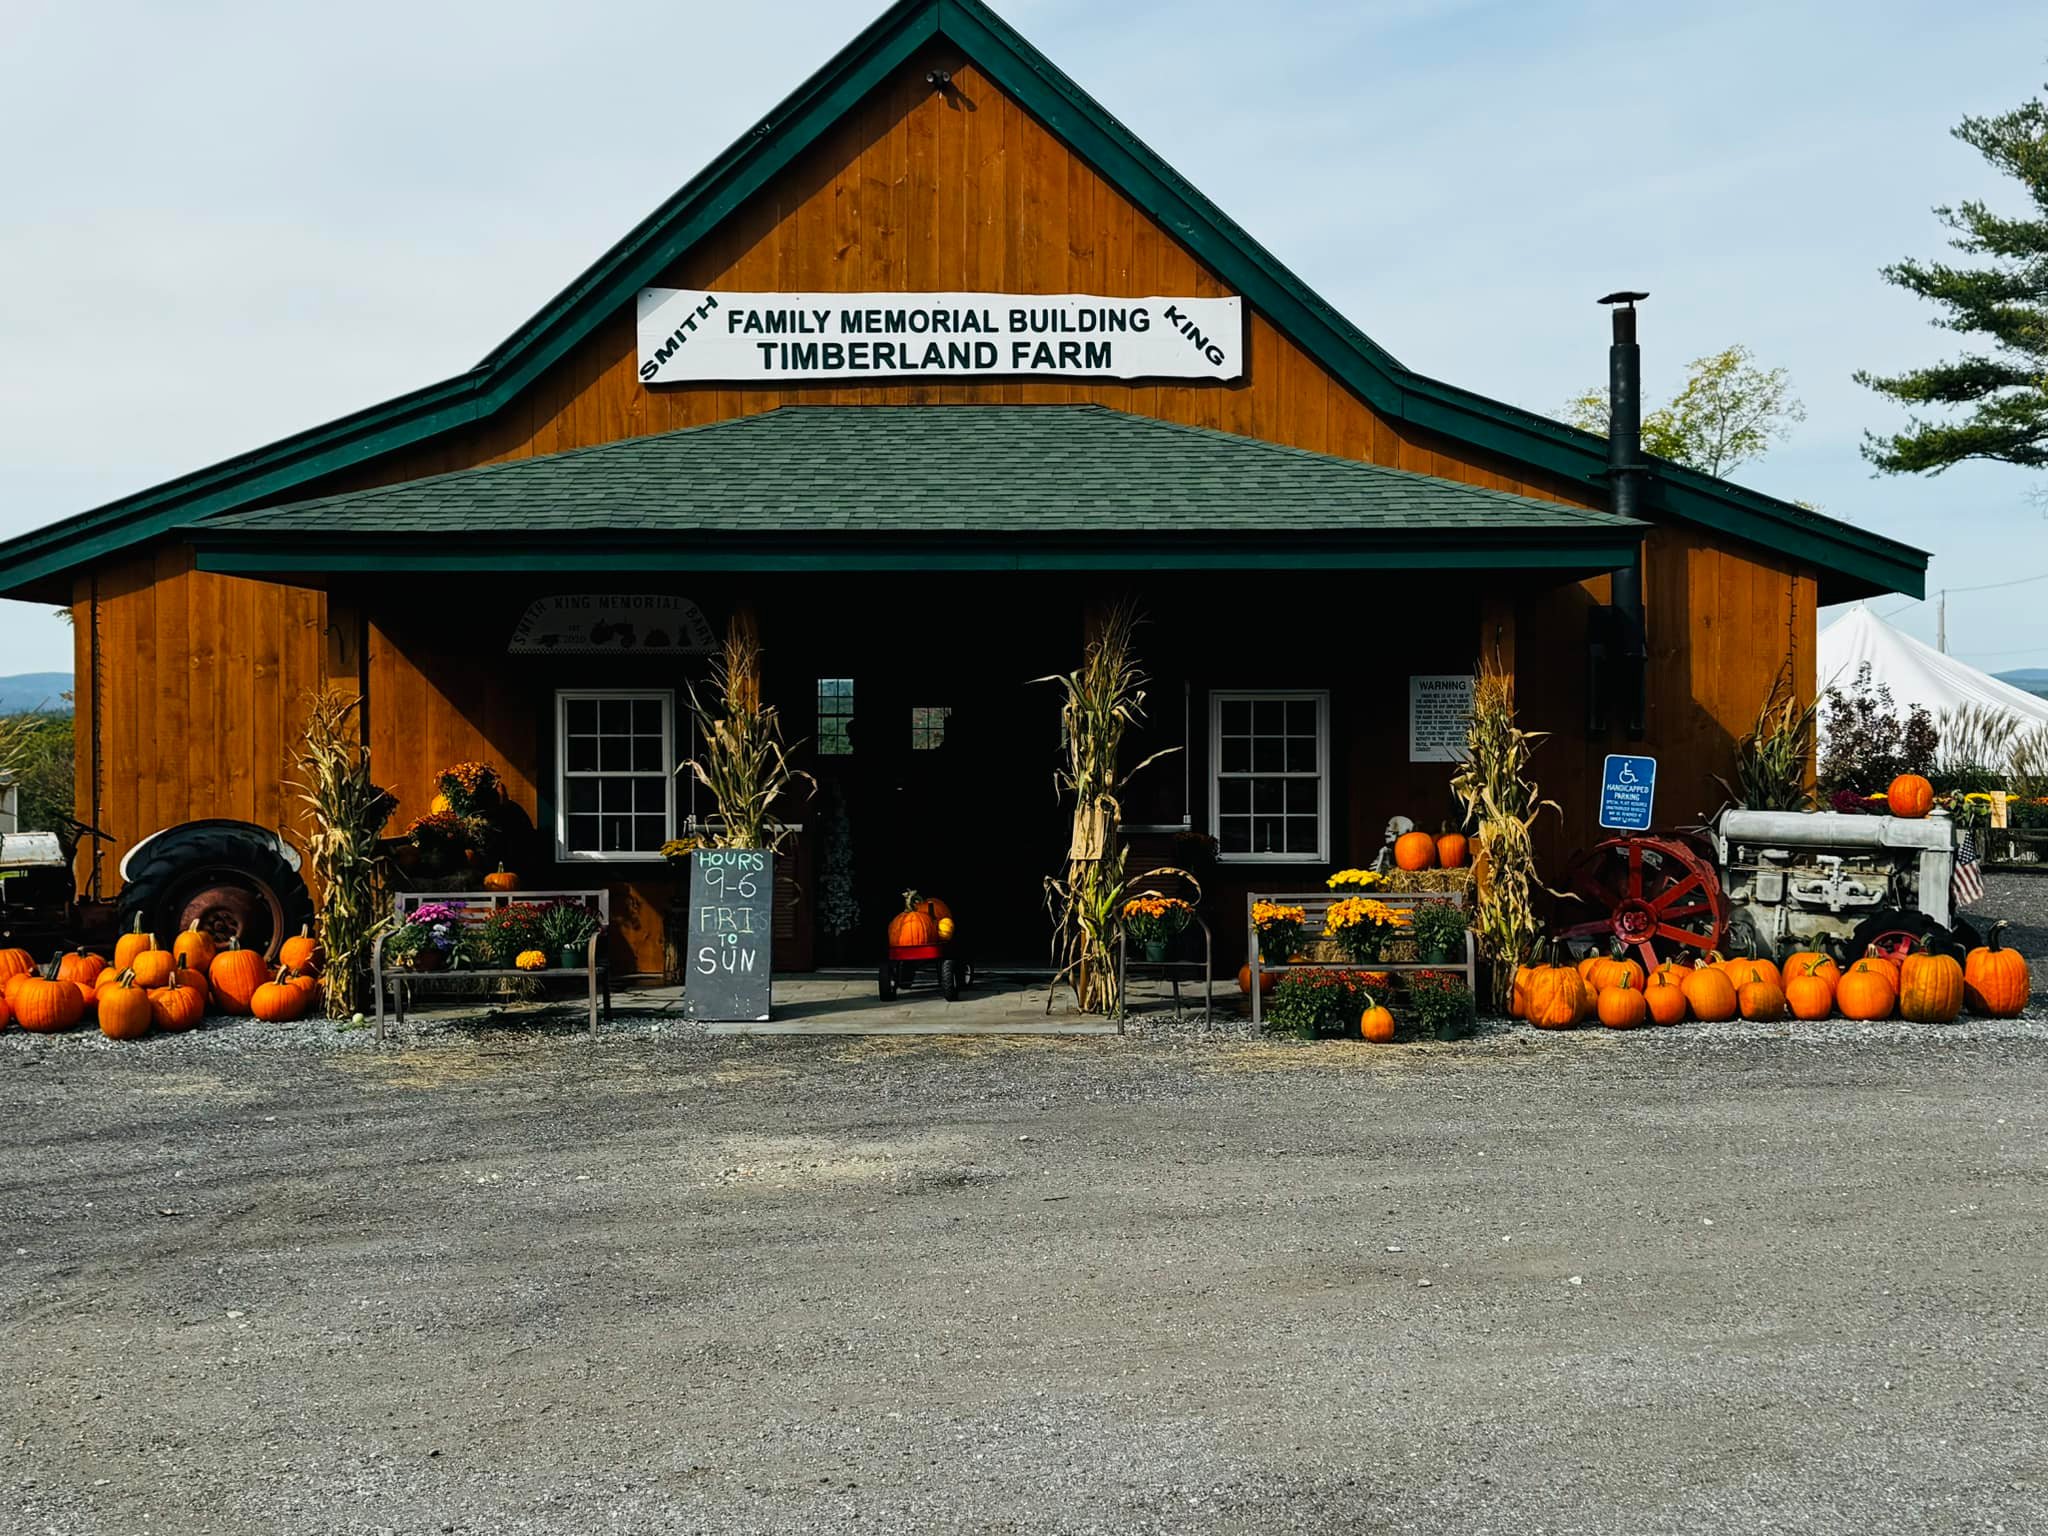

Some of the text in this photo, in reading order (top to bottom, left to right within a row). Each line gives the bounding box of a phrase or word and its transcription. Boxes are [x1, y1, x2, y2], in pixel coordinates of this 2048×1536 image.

[640, 295, 1226, 381] SMITH FAMILY MEMORIAL BUILDING KING
[757, 341, 1113, 371] TIMBERLAND FARM
[513, 601, 547, 645] SMITH
[554, 597, 591, 609] KING
[599, 597, 680, 609] MEMORIAL
[1418, 680, 1467, 691] WARNING
[1606, 784, 1650, 794] HANDICAPPED
[1614, 792, 1641, 801] PARKING
[700, 852, 764, 871] HOURS
[705, 867, 757, 898] 9-6
[701, 906, 754, 933] FRI
[718, 933, 738, 947] TO
[696, 946, 756, 974] SUN
